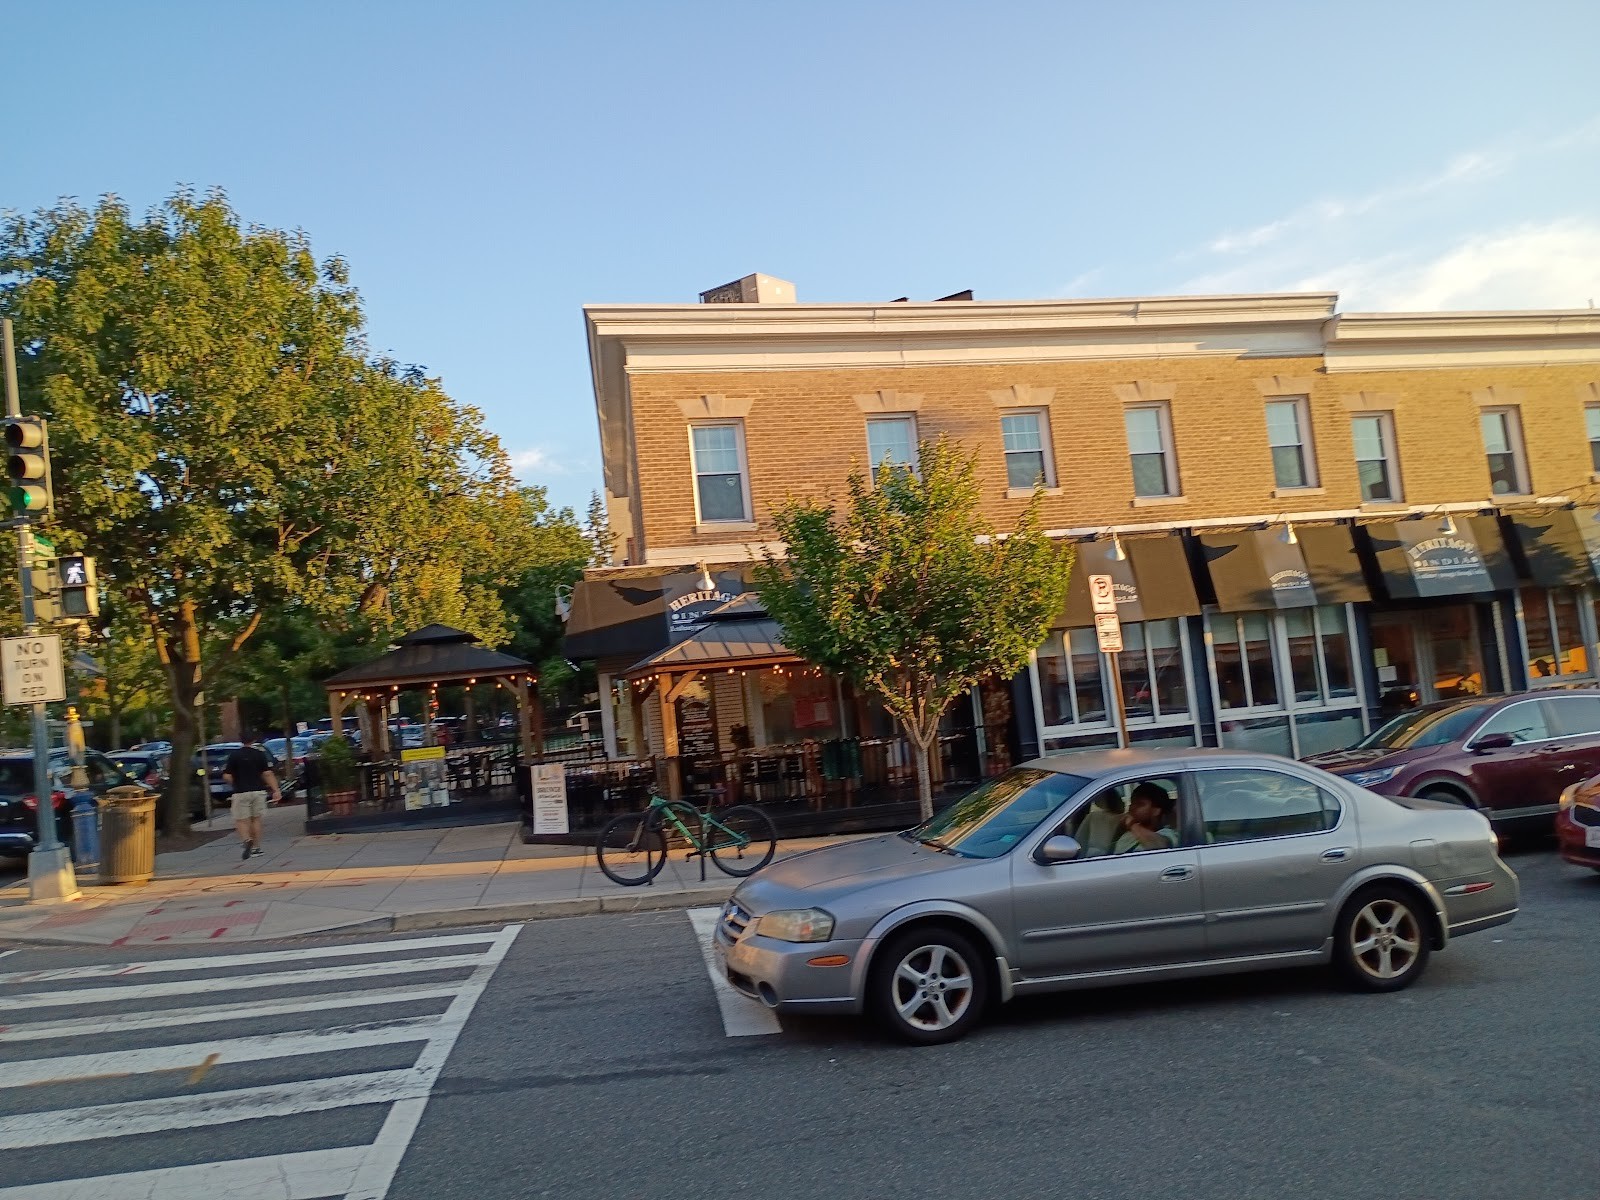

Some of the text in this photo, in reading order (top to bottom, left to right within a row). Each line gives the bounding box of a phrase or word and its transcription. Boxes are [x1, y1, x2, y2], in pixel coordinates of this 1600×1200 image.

[16, 642, 44, 655] NO
[13, 658, 49, 670] TURN
[22, 672, 43, 683] ON
[20, 686, 47, 698] RED
